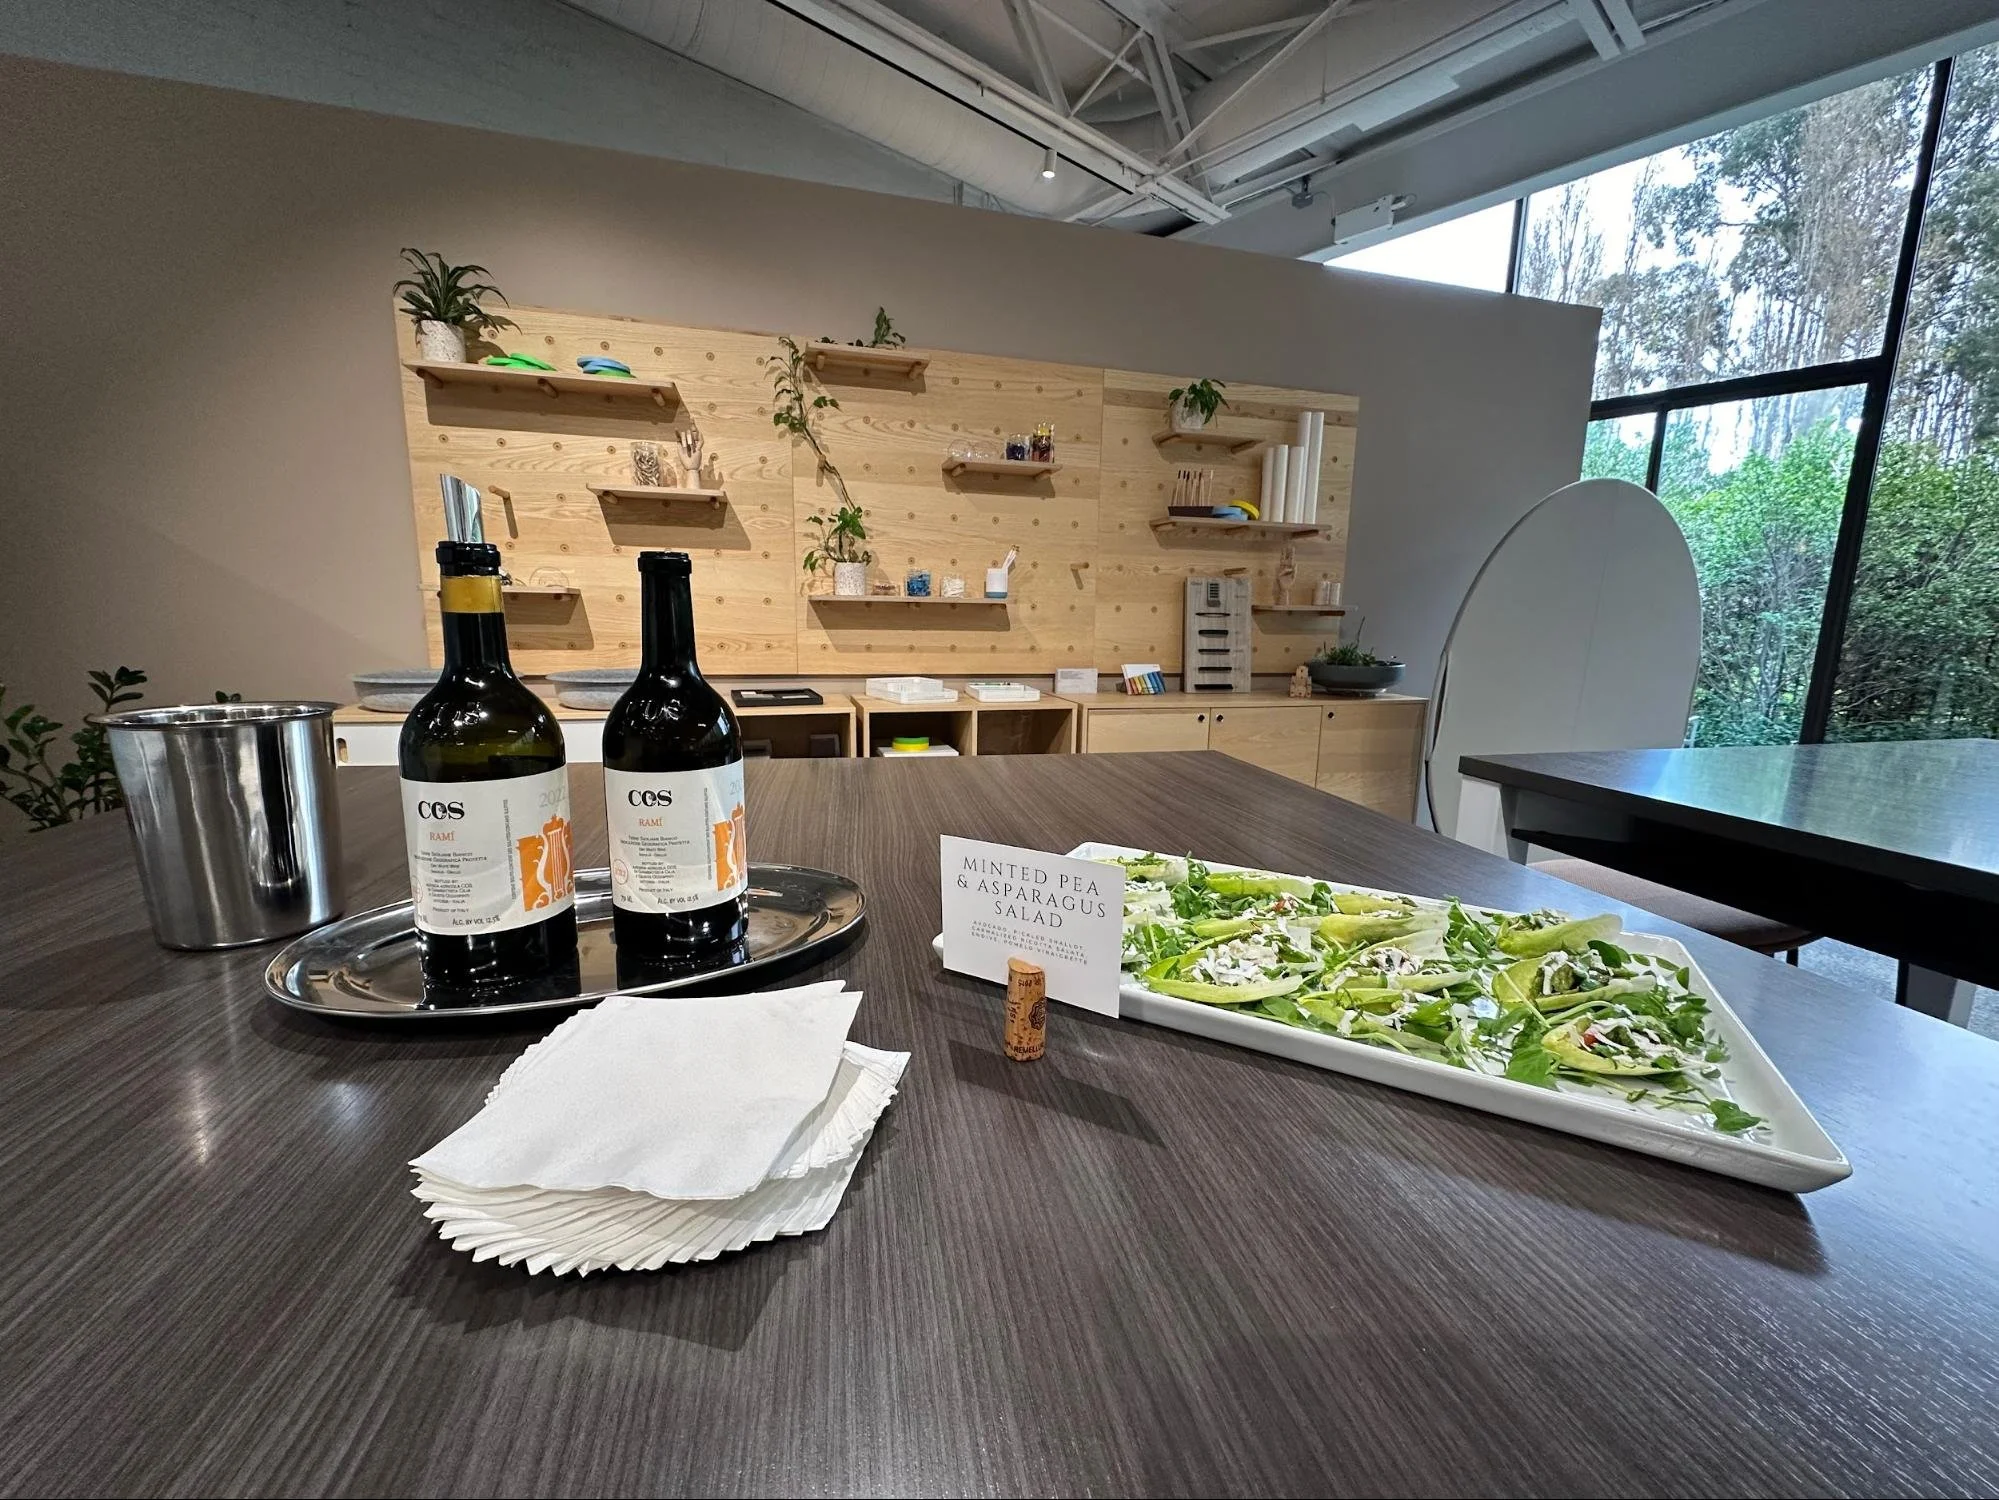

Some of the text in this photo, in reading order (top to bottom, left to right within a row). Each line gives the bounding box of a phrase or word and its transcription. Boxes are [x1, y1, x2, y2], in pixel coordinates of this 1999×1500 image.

[957, 874, 1106, 918] & ASPARAGUS
[963, 856, 1099, 896] MINTED PEA
[994, 900, 1063, 928] SALAD
